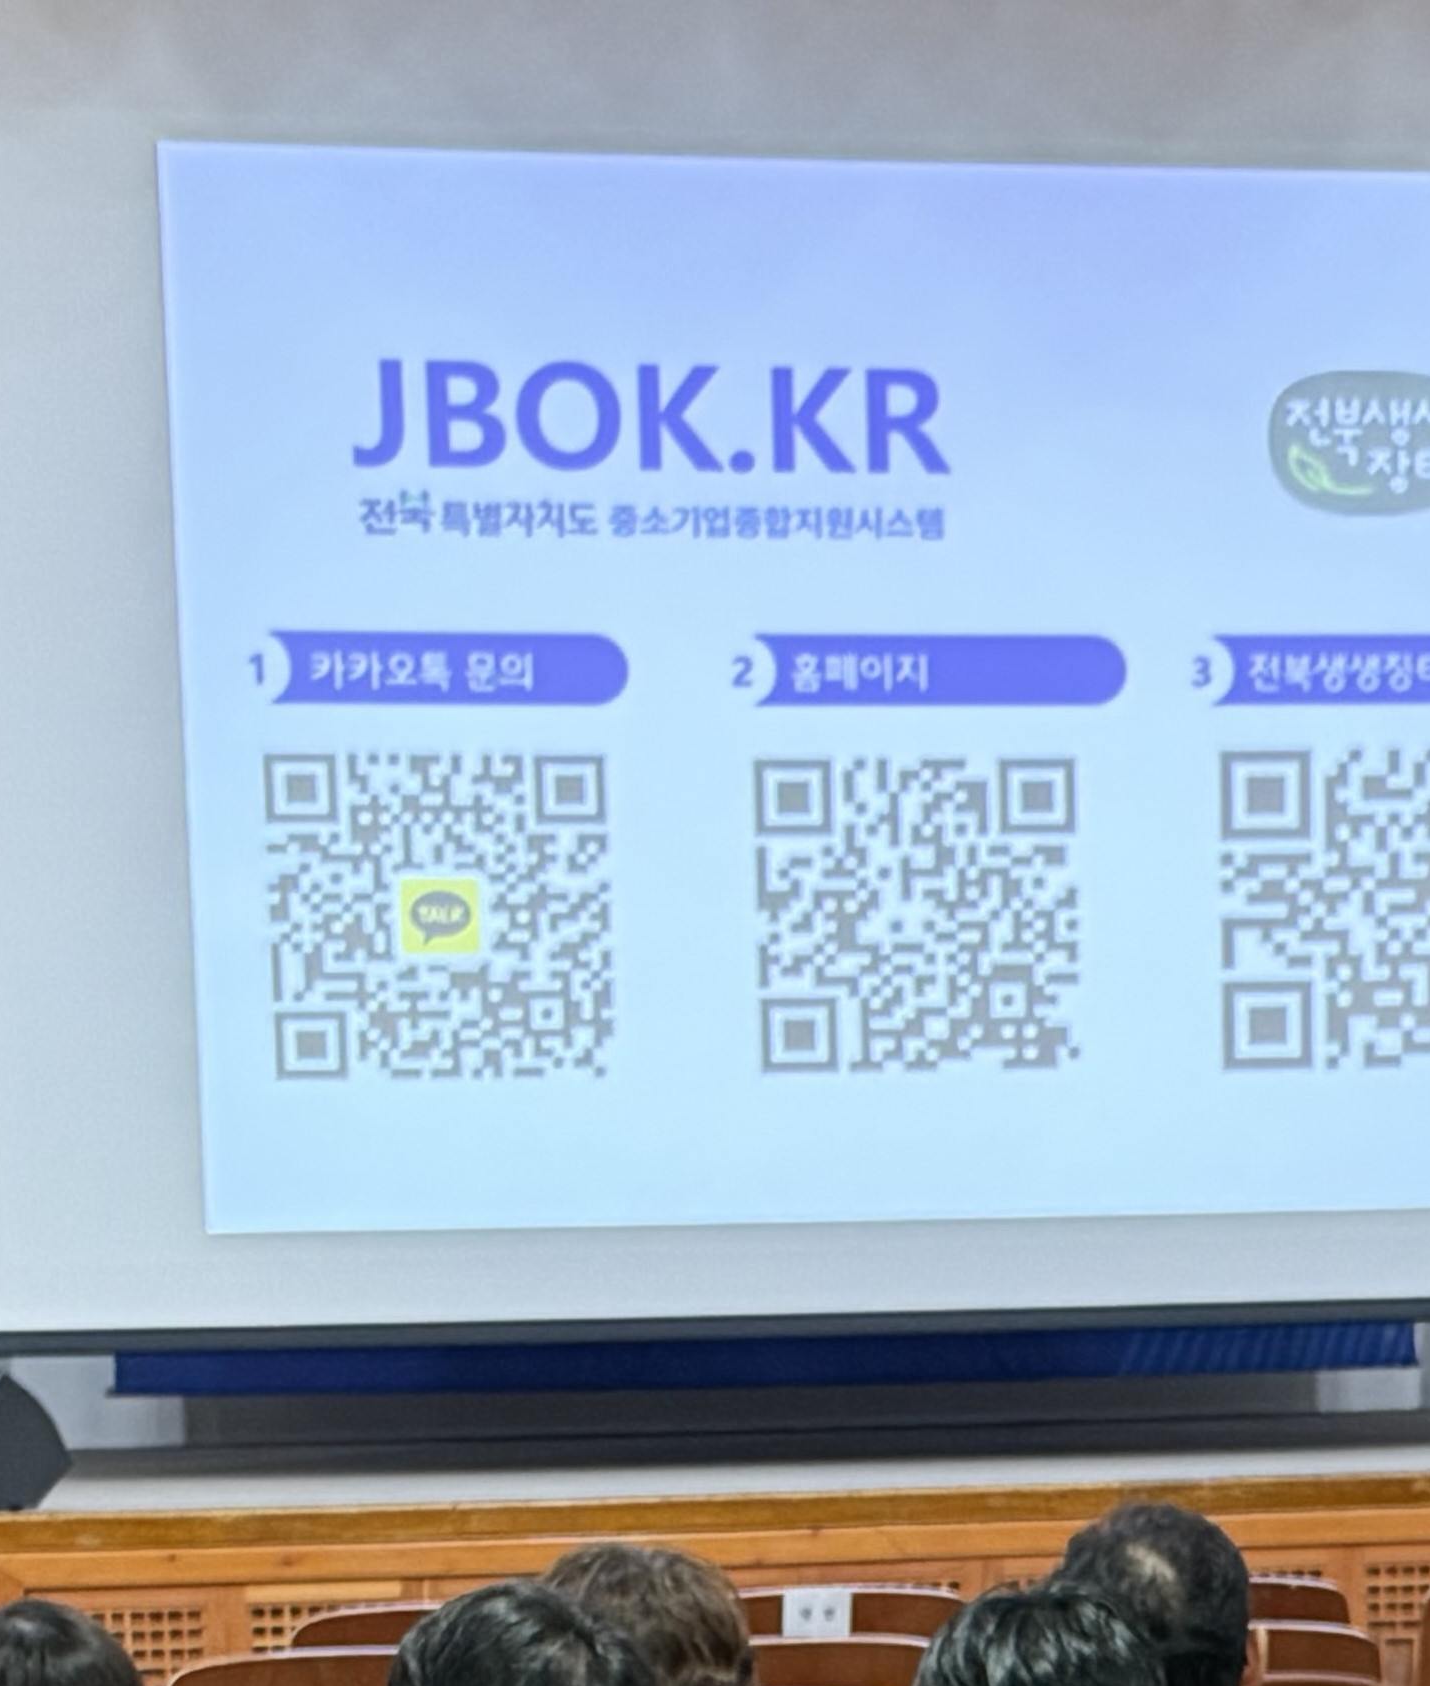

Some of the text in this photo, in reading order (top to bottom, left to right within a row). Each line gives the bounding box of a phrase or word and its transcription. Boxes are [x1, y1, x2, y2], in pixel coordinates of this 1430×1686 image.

[353, 358, 952, 476] JBOK.KR
[358, 489, 436, 536] 전북
[248, 652, 266, 687] 1
[309, 650, 452, 693] 카카오톡
[731, 652, 930, 694] 2 홈페이지
[1190, 655, 1213, 689] 3
